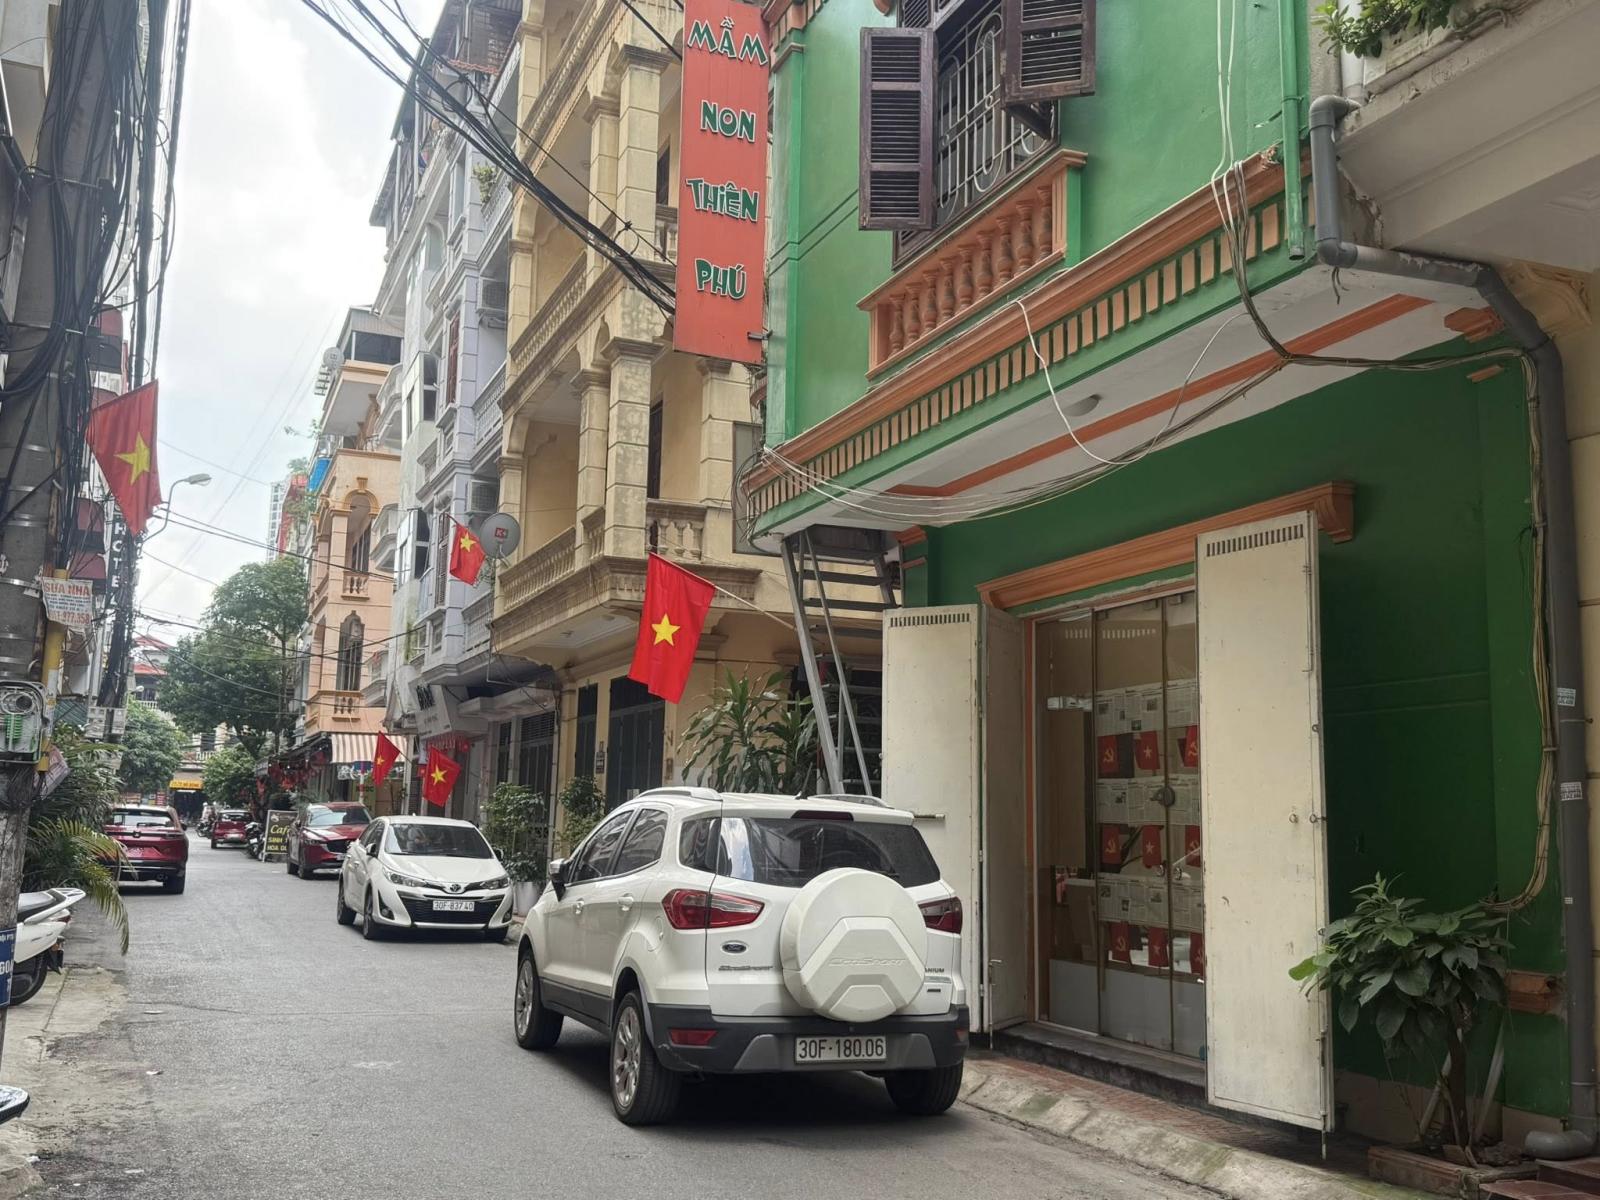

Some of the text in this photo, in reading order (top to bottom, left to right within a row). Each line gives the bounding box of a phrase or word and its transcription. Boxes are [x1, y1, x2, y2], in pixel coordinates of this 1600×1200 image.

[688, 16, 768, 66] MẦM
[701, 100, 756, 143] NON
[695, 258, 746, 300] PHÚ
[798, 1038, 885, 1059] 30F-180.06
